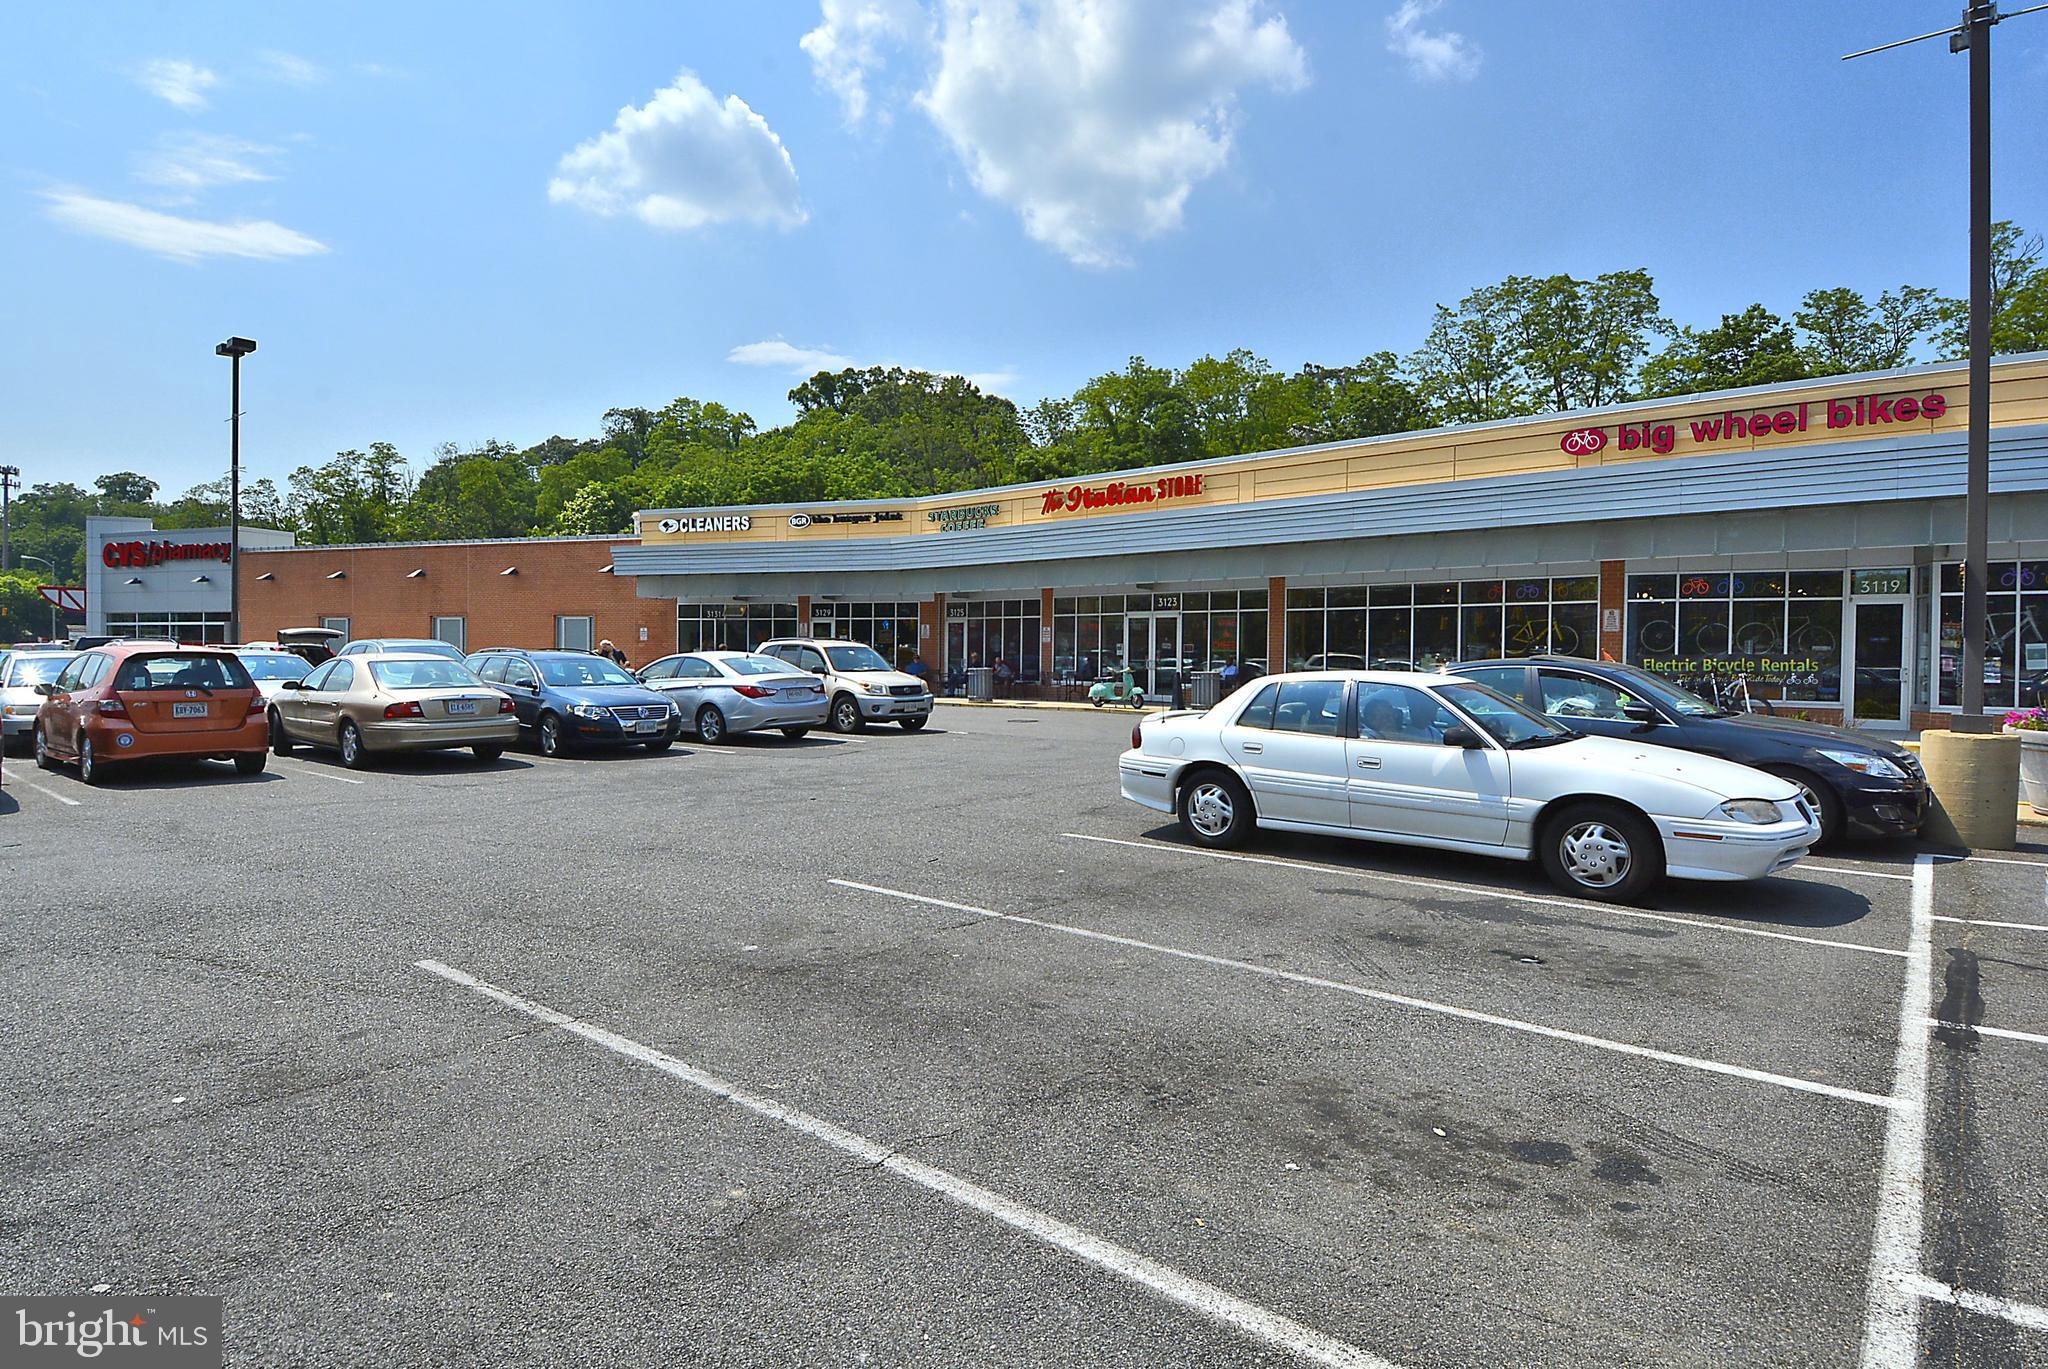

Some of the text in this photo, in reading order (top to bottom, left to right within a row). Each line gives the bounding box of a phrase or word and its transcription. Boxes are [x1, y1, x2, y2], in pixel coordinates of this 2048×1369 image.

[1617, 393, 1947, 454] big wheel bikes
[1066, 482, 1157, 513] Italian
[1157, 474, 1205, 499] STORE
[927, 504, 1000, 522] STARBUCKS
[680, 515, 751, 532] CLEANERS
[791, 517, 807, 525] BGR
[940, 519, 986, 533] COFFEE
[1860, 579, 1901, 593] 3119
[1157, 597, 1178, 607] 3123
[706, 610, 721, 618] 3131
[815, 608, 832, 617] 3129
[949, 608, 965, 617] 3125
[1643, 657, 1819, 674] Electric Bicycle Rentals
